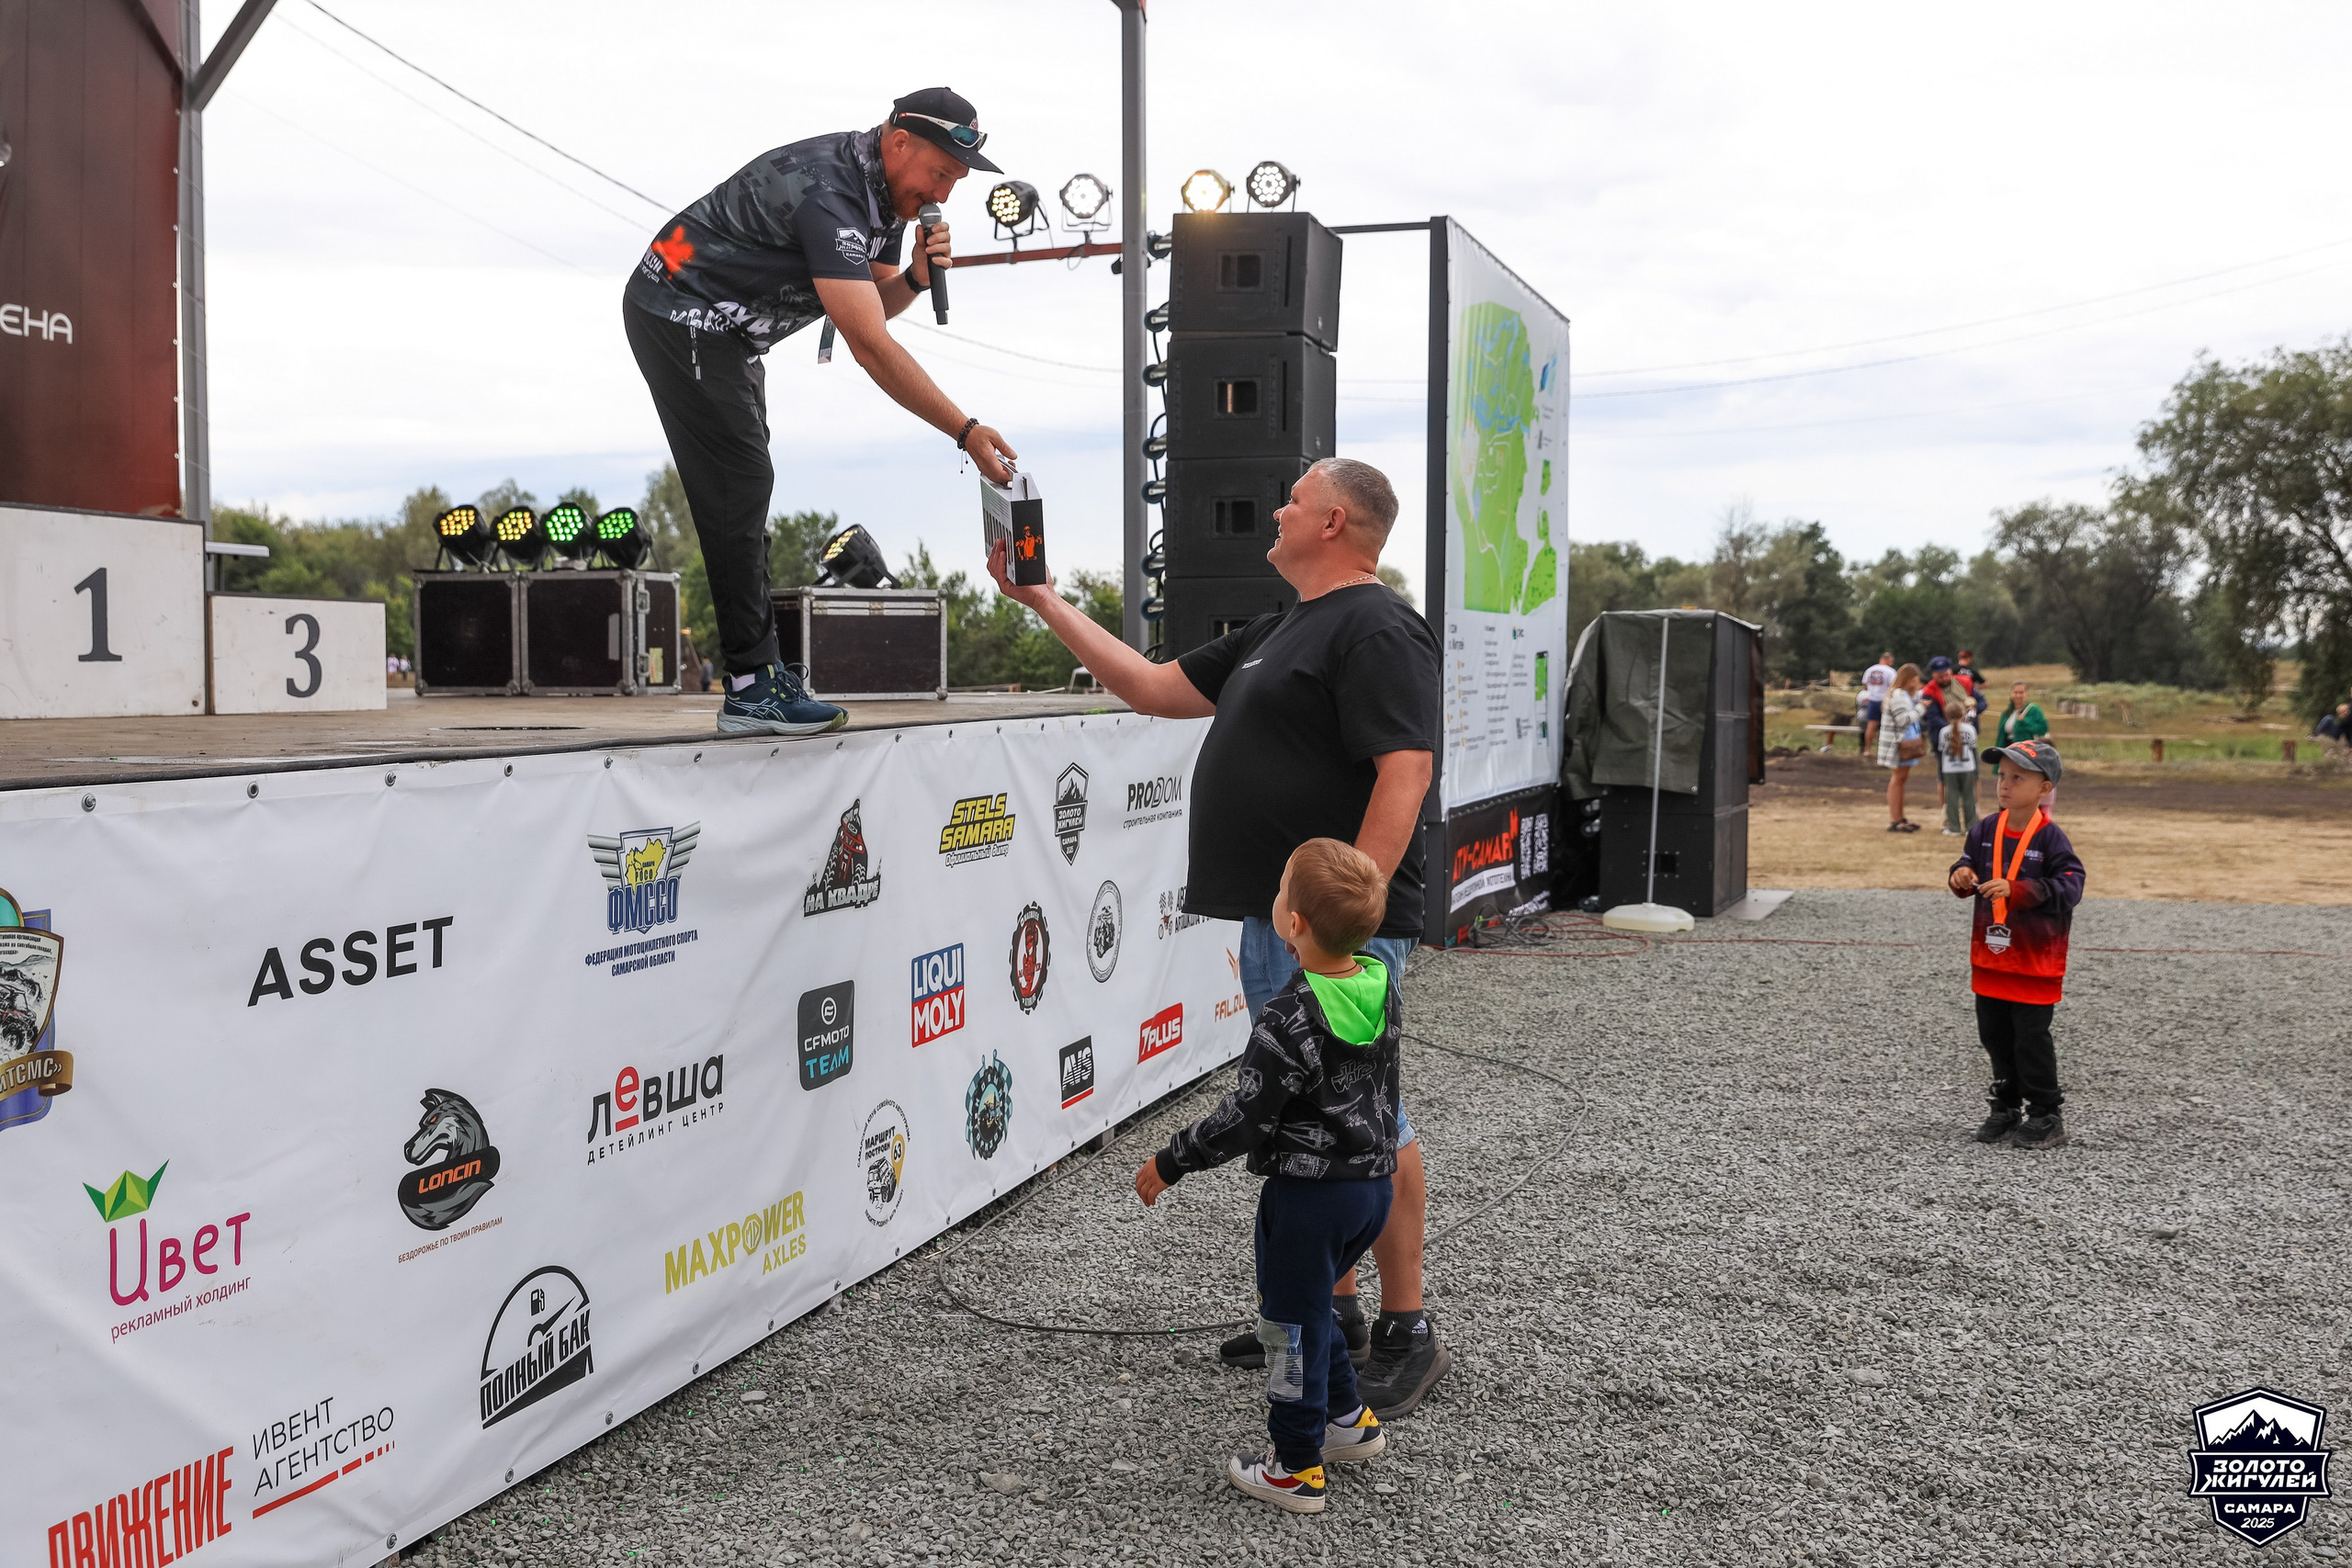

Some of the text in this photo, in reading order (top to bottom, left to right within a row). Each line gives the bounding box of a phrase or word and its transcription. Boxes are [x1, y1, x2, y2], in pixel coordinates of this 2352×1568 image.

[74, 567, 122, 661] 1
[285, 613, 322, 698] 3
[951, 795, 1007, 825] STELS
[1057, 814, 1083, 832] ЖИГУЛЕЙ
[1058, 807, 1081, 819] ЗОЛОТО
[940, 817, 1014, 852] SAMARA
[1062, 836, 1078, 845] САМАРА
[608, 877, 679, 934] ФМССО
[805, 880, 879, 913] НА КВАДРЕ
[247, 915, 454, 1008] ASSET
[584, 930, 698, 966] ФЕДЕРАЦИЯ МОТОЦИКЛЕТНОГО СПОРТА
[611, 950, 676, 976] САМАРСКОЙ ОБЛАСТИ
[913, 947, 962, 998] LIQUI
[913, 988, 964, 1043] MOLY
[1140, 1017, 1182, 1056] 7PLUS
[804, 1024, 850, 1052] CFMOTO
[806, 1045, 850, 1078] TEAM
[1062, 1046, 1092, 1090] AVS
[587, 1102, 724, 1166] ДЕТЕЙЛИНГ ЦЕНТР
[865, 1125, 896, 1150] МАРШРУТ
[865, 1142, 890, 1160] ПОСТРОЕН
[894, 1143, 902, 1160] 63
[418, 1159, 481, 1194] LONCIN
[109, 1212, 251, 1306] Цвет
[398, 1216, 503, 1263] БЕЗДОРОЖЬЕ ПО ТВОИМ ПРАВИЛАМ
[664, 1190, 806, 1295] MAXPOWER
[763, 1233, 807, 1276] AXLES
[110, 1277, 252, 1344] рекламный холдинг
[481, 1308, 591, 1422] ПОЛНЫЙ БАК
[253, 1397, 334, 1461] ИВЕНТ
[254, 1406, 394, 1497] АГЕНТСТВО
